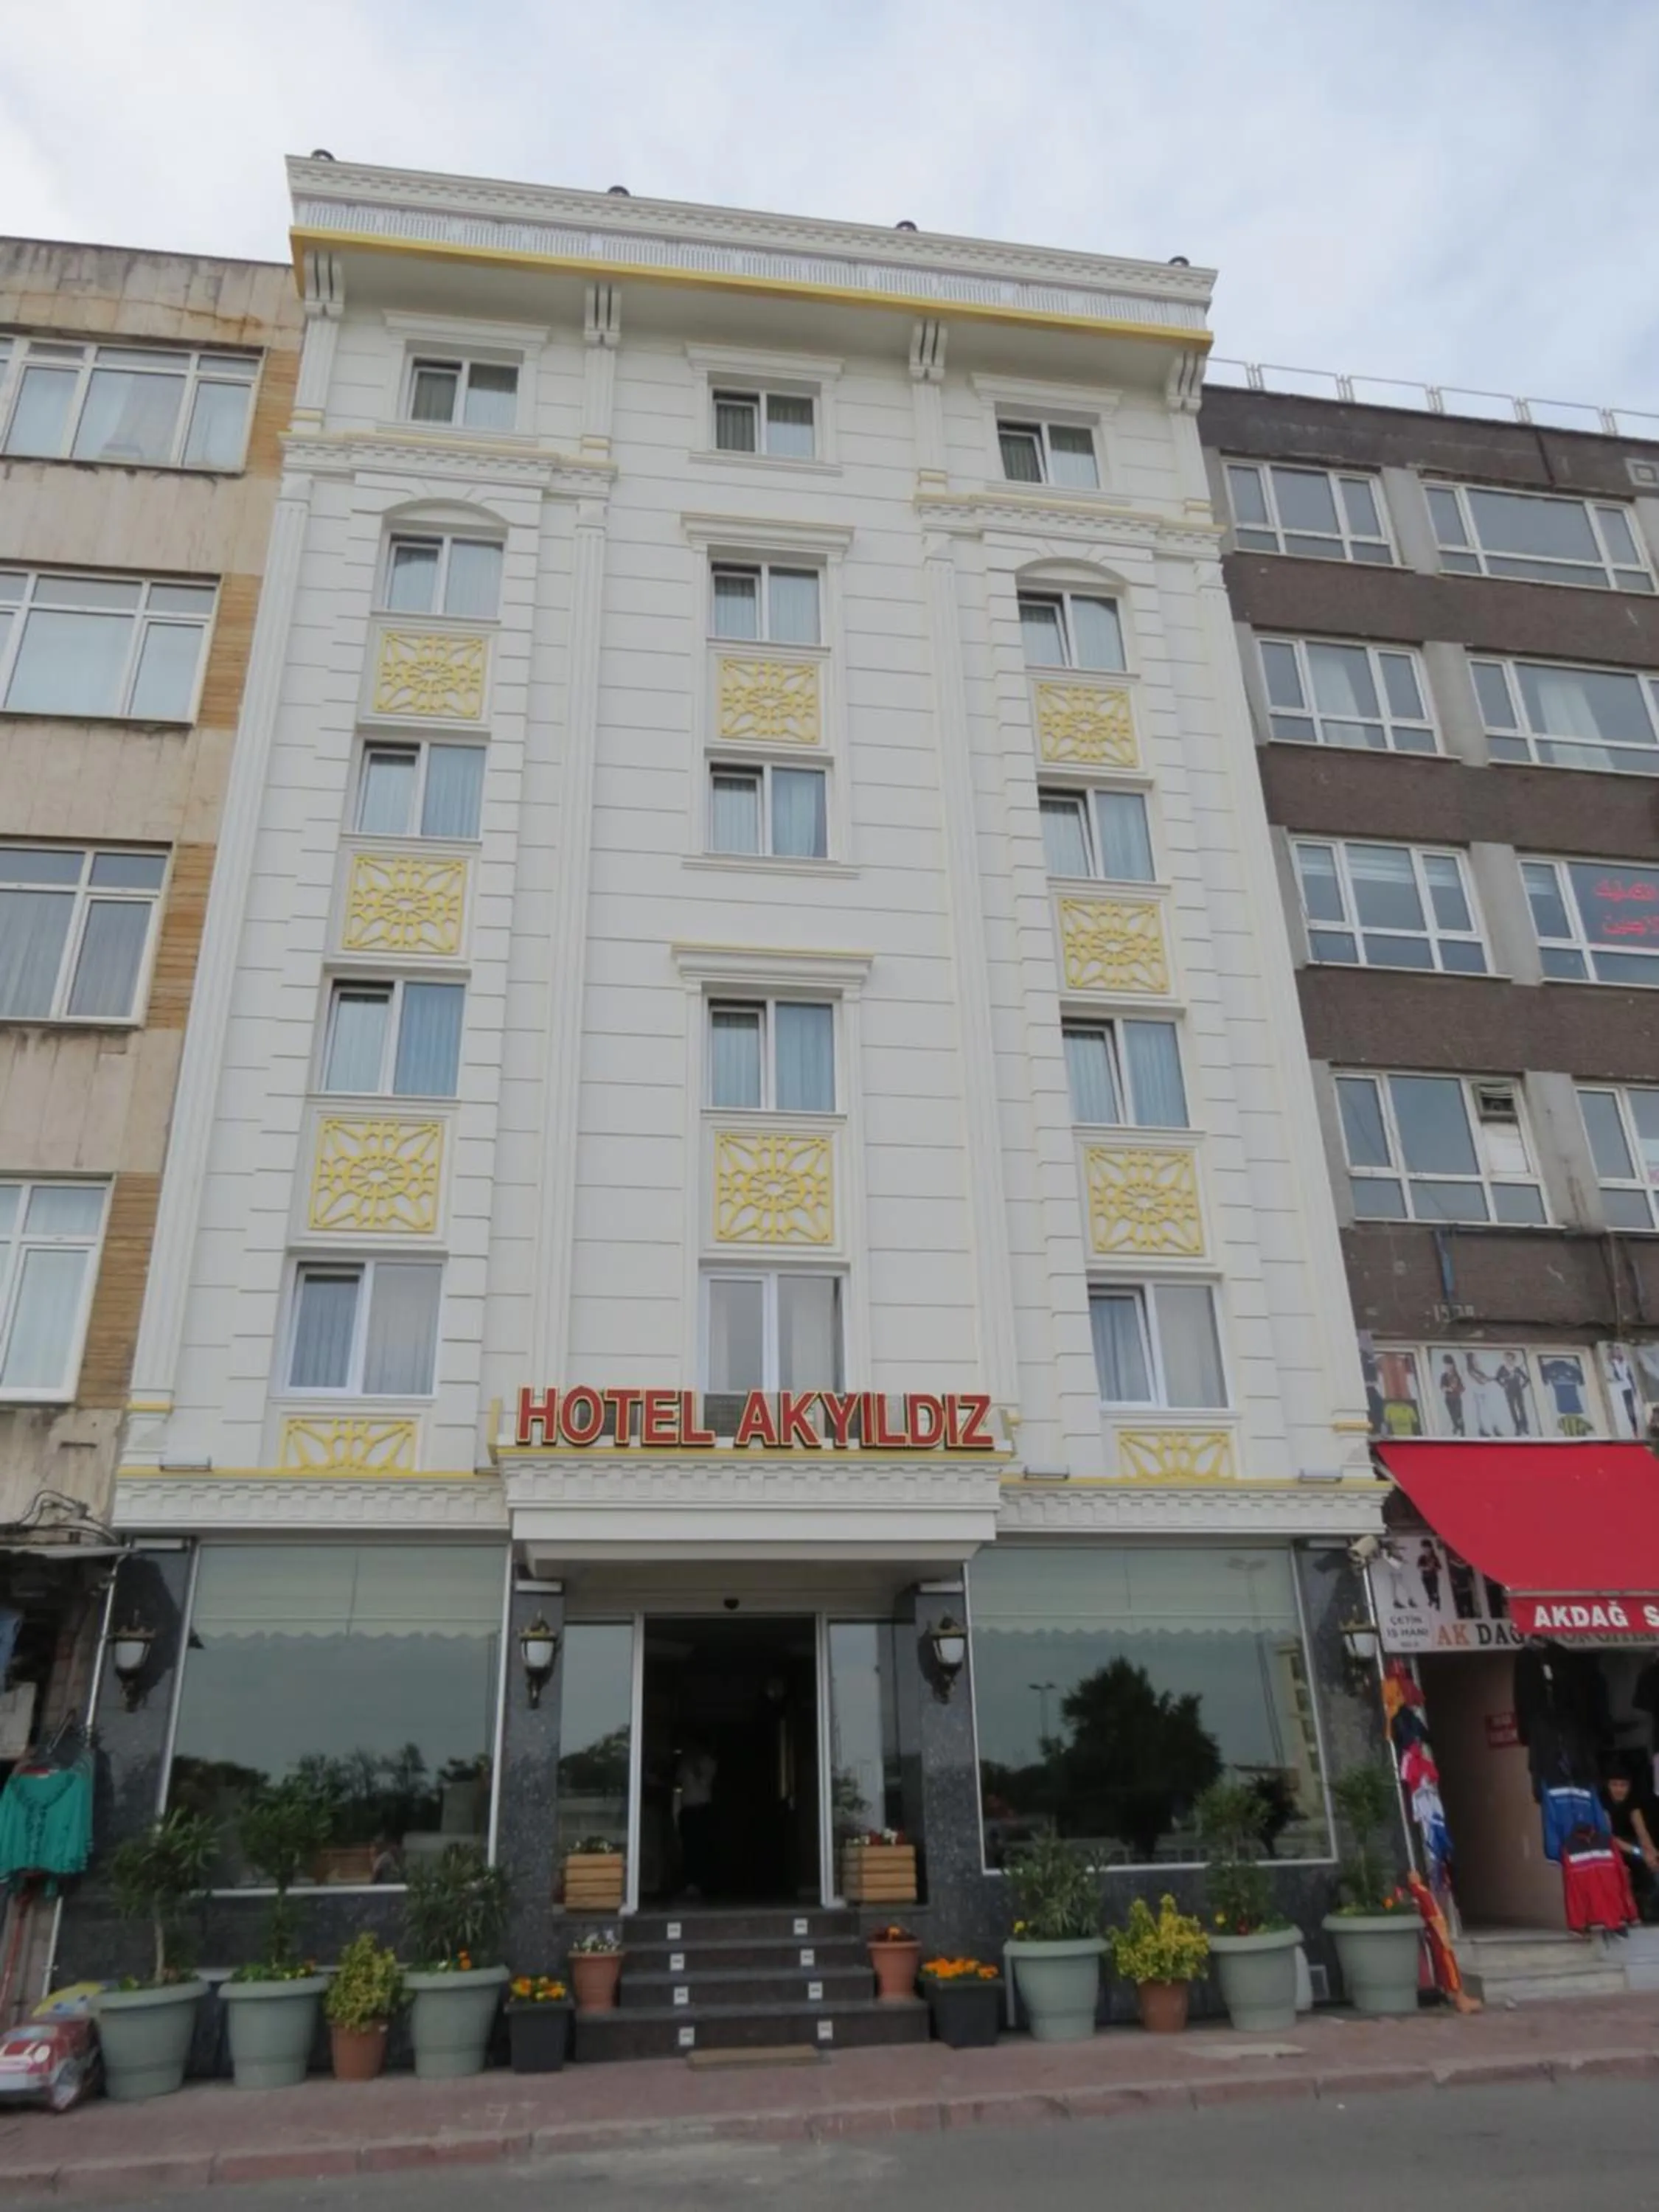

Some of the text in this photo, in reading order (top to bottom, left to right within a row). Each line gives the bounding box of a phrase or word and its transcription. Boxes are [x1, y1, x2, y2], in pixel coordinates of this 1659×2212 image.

[517, 1386, 994, 1450] HOTEL AKYILDIZ
[1534, 1600, 1629, 1627] AKDAĞ
